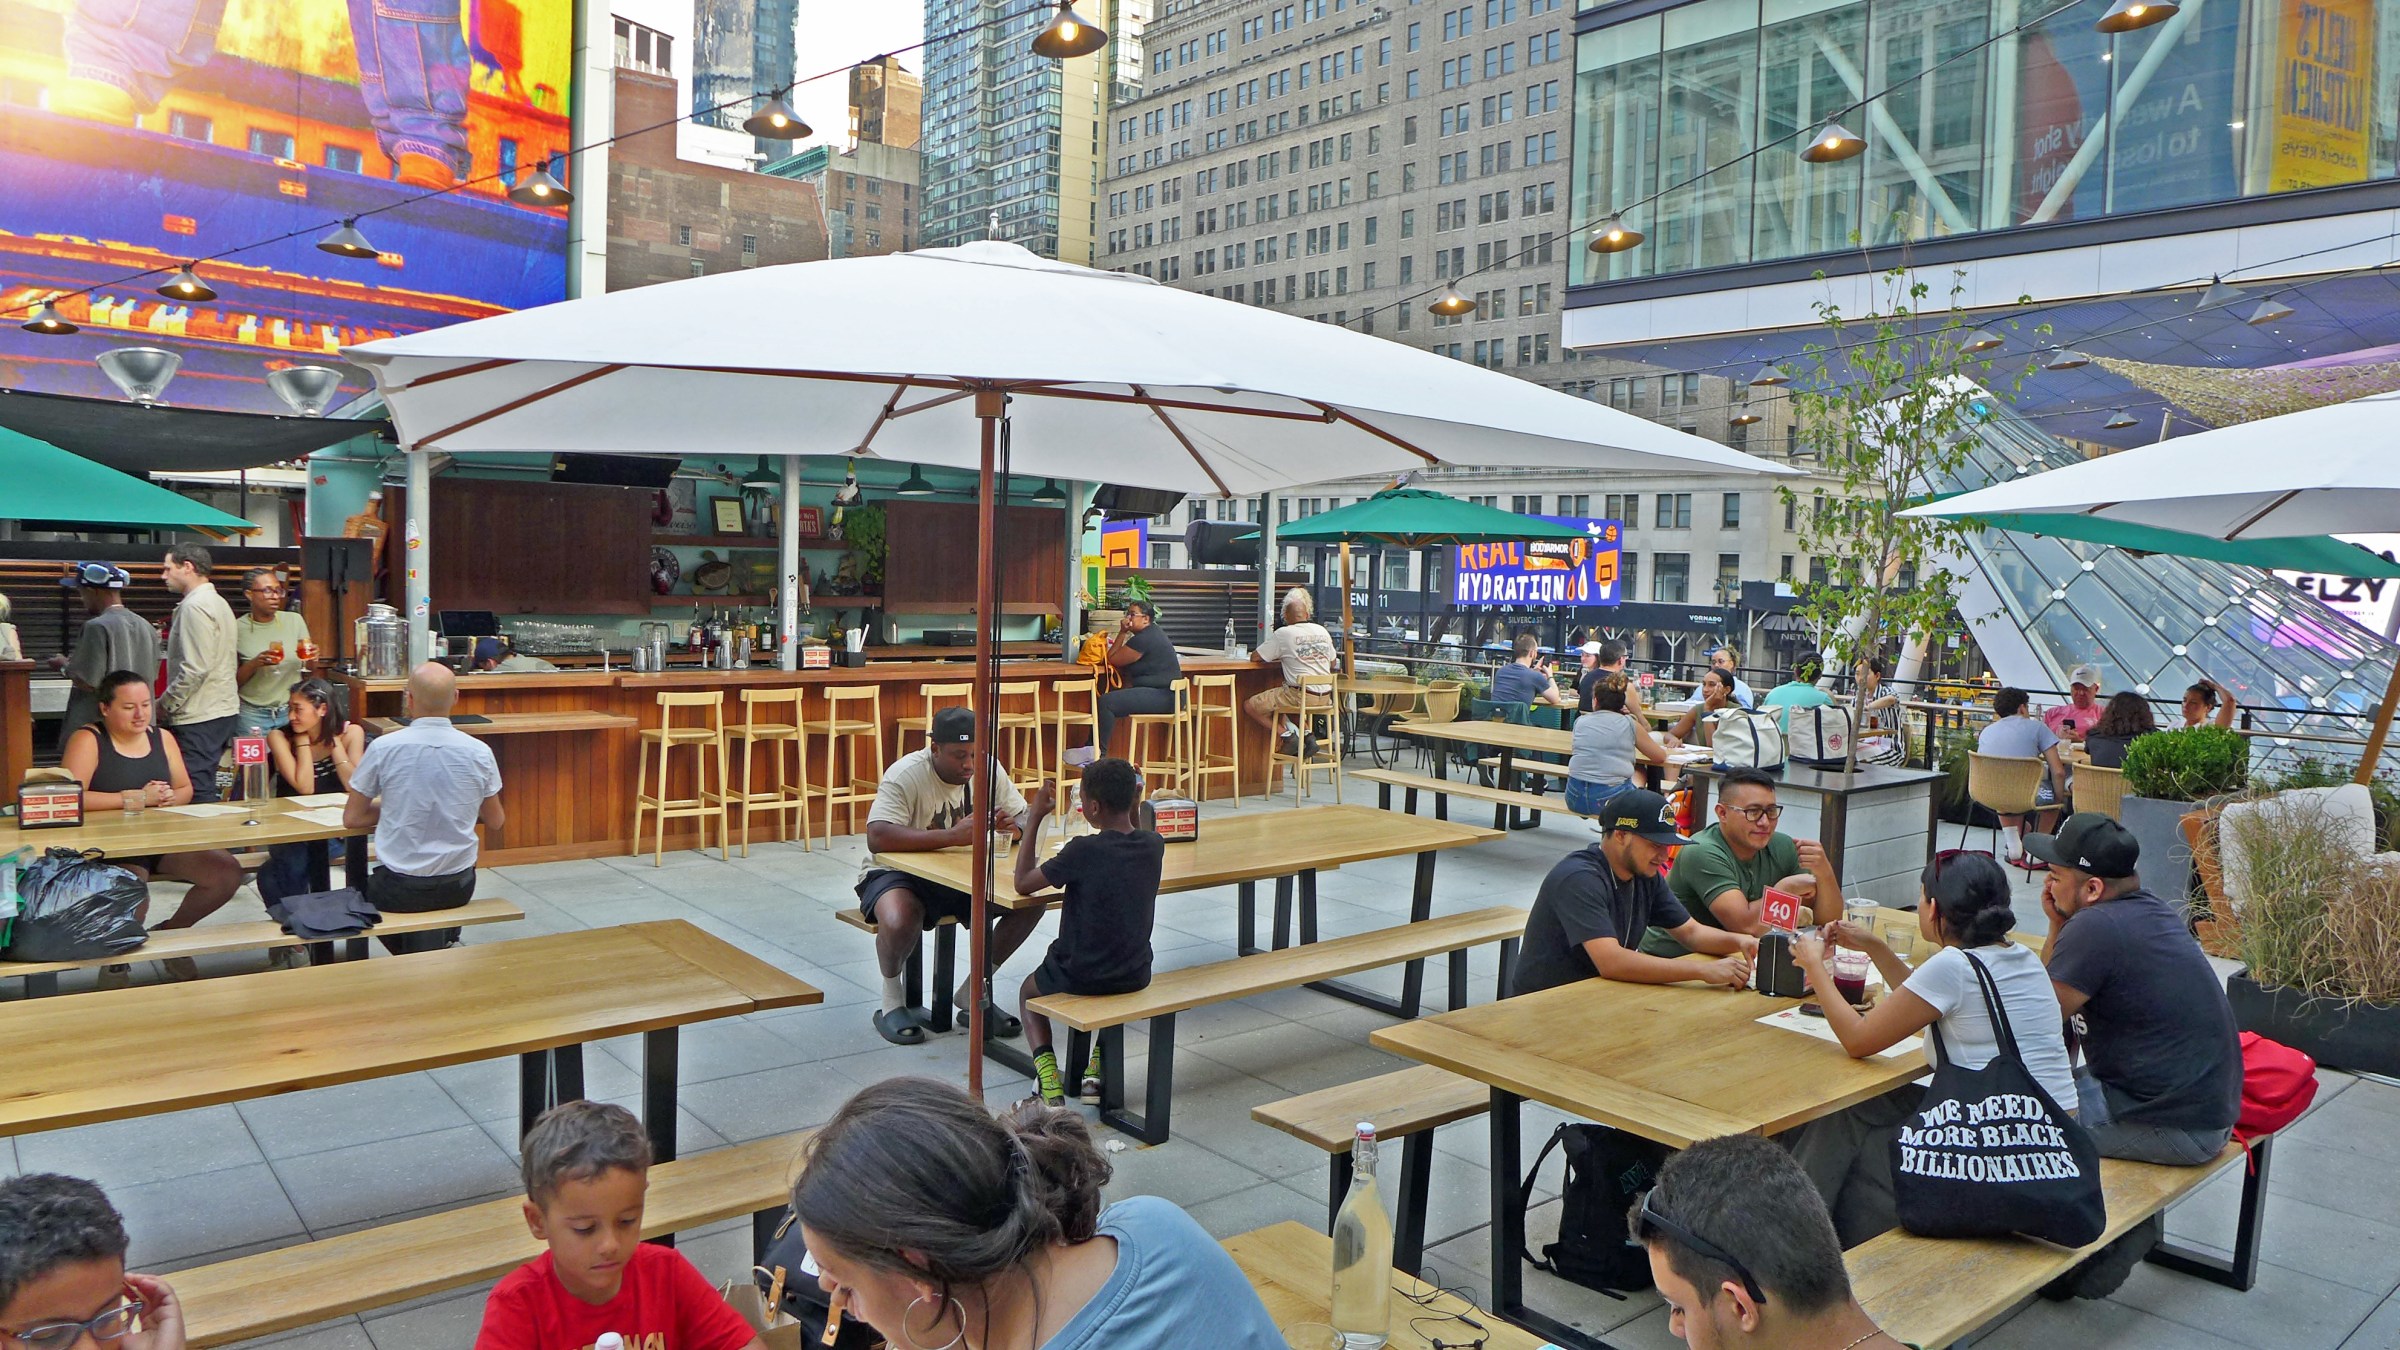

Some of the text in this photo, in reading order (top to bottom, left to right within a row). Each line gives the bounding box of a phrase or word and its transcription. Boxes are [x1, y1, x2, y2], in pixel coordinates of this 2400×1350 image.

[1461, 541, 1519, 570] REAL
[1530, 542, 1569, 554] BODYARMOR
[1458, 572, 1565, 603] HYDRATION
[1378, 594, 1388, 608] 11
[1689, 614, 1723, 623] VORNADO
[242, 745, 260, 758] 36
[1769, 900, 1791, 921] 40
[1919, 1099, 1962, 1128] WE
[1898, 1122, 2068, 1149] MORE BLACK
[1900, 1145, 2081, 1183] BILLIONAIRES
